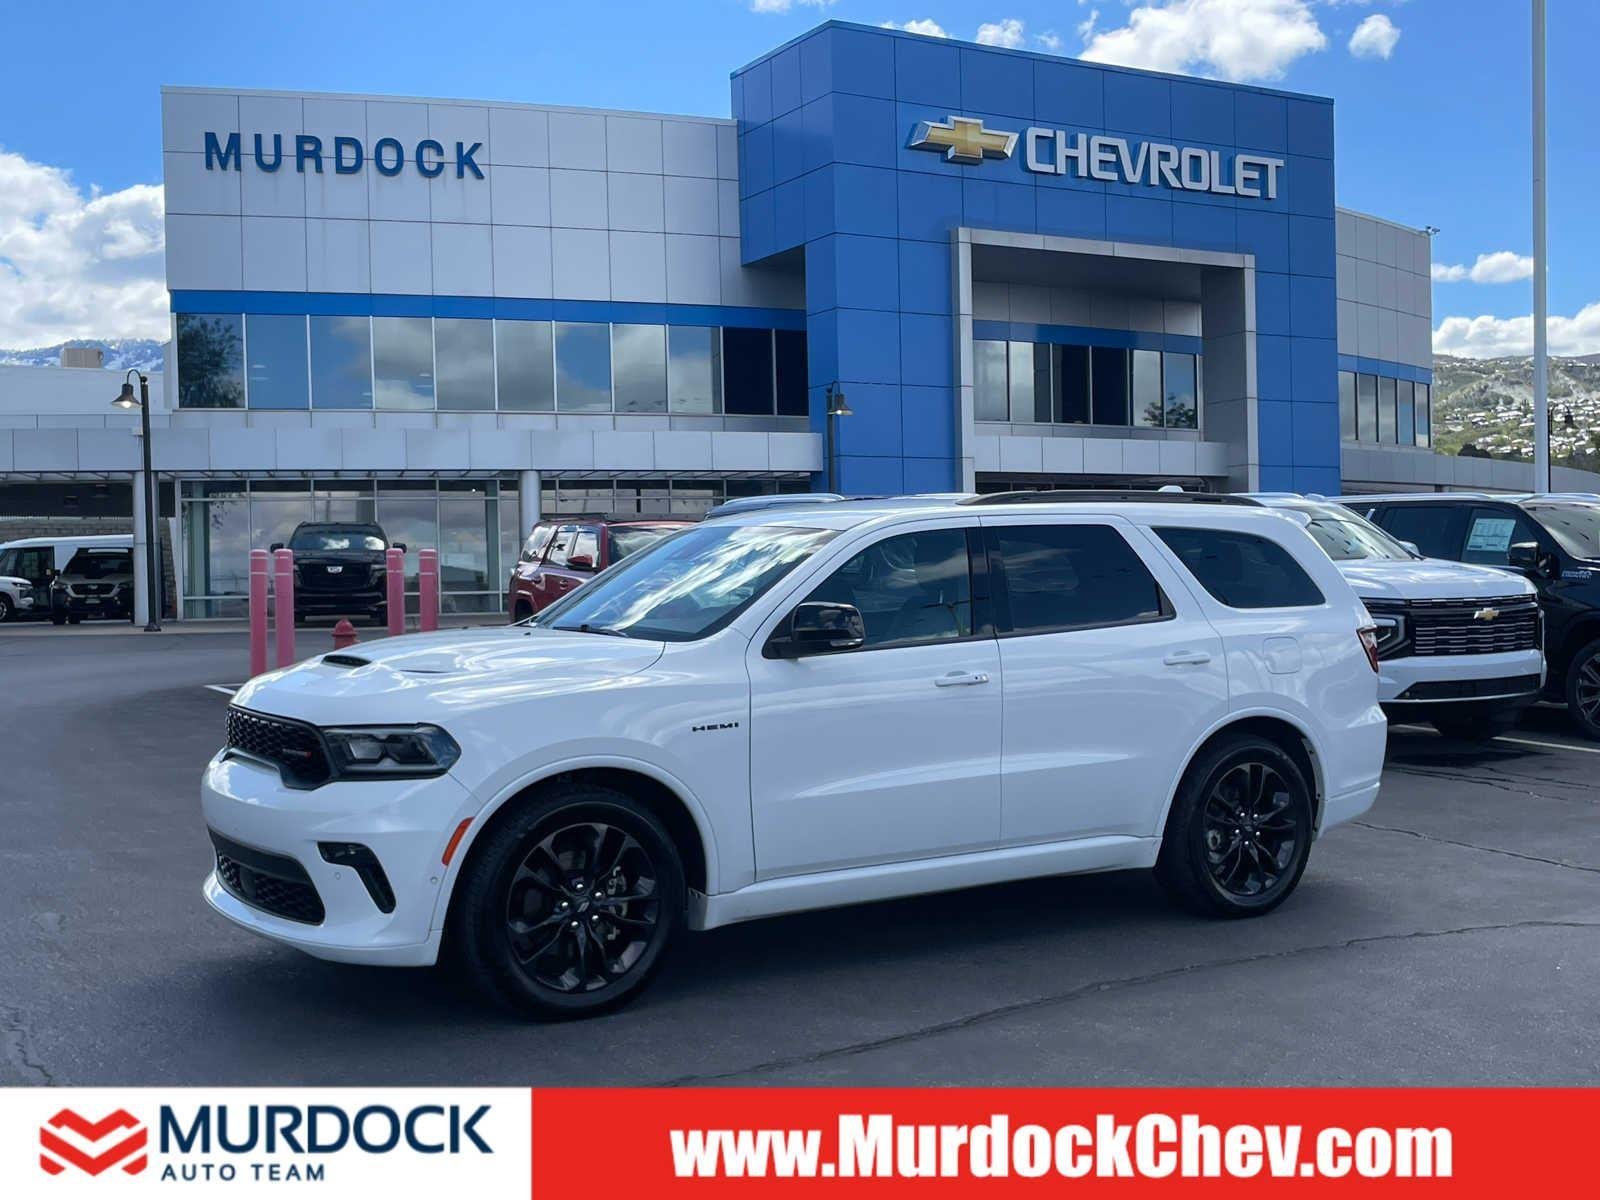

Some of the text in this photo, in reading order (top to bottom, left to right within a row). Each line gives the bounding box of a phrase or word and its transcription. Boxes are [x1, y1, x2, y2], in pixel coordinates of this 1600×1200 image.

[204, 131, 485, 180] MURDOCK
[1025, 126, 1285, 199] CHEVROLET
[691, 722, 739, 732] HEMI
